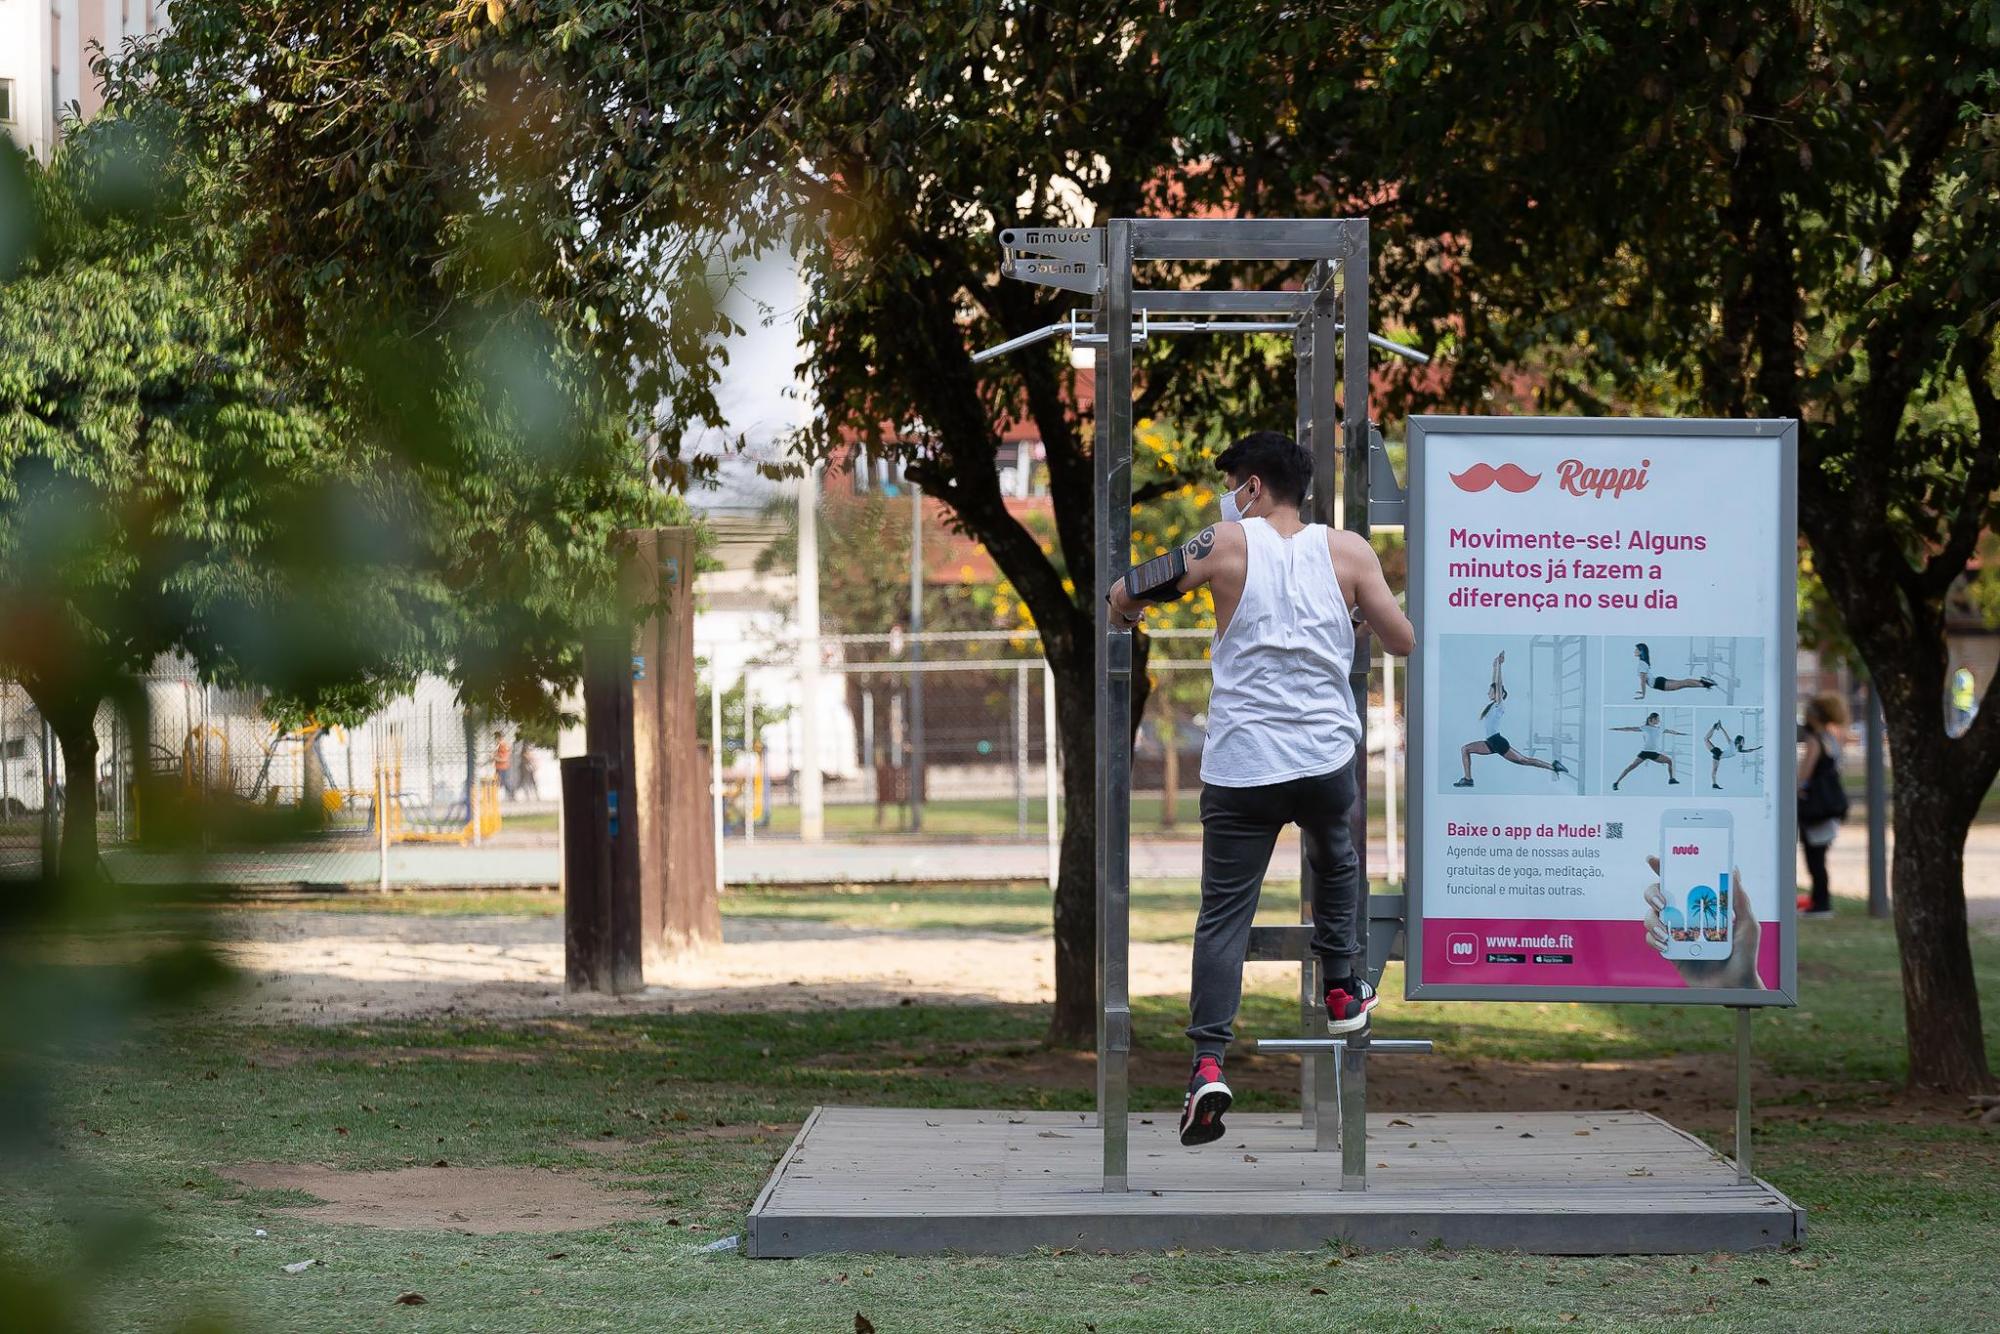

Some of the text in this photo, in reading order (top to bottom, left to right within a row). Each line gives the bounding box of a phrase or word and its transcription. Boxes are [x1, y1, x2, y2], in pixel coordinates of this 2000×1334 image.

[1556, 459, 1651, 499] Rappi
[1449, 528, 1707, 555] Movimente-se! Alguns
[1449, 558, 1662, 583] minutos já fazem a
[1448, 587, 1678, 612] diferença no seu dia
[1447, 822, 1601, 840] Baixe o app da Mude!
[1447, 846, 1600, 859] Agende uma de nossas aulas
[1446, 864, 1605, 879] gratuitas de yoga, meditação,
[1447, 883, 1585, 896] funcional e muitas outras.
[1486, 934, 1574, 948] www.mude.fit
